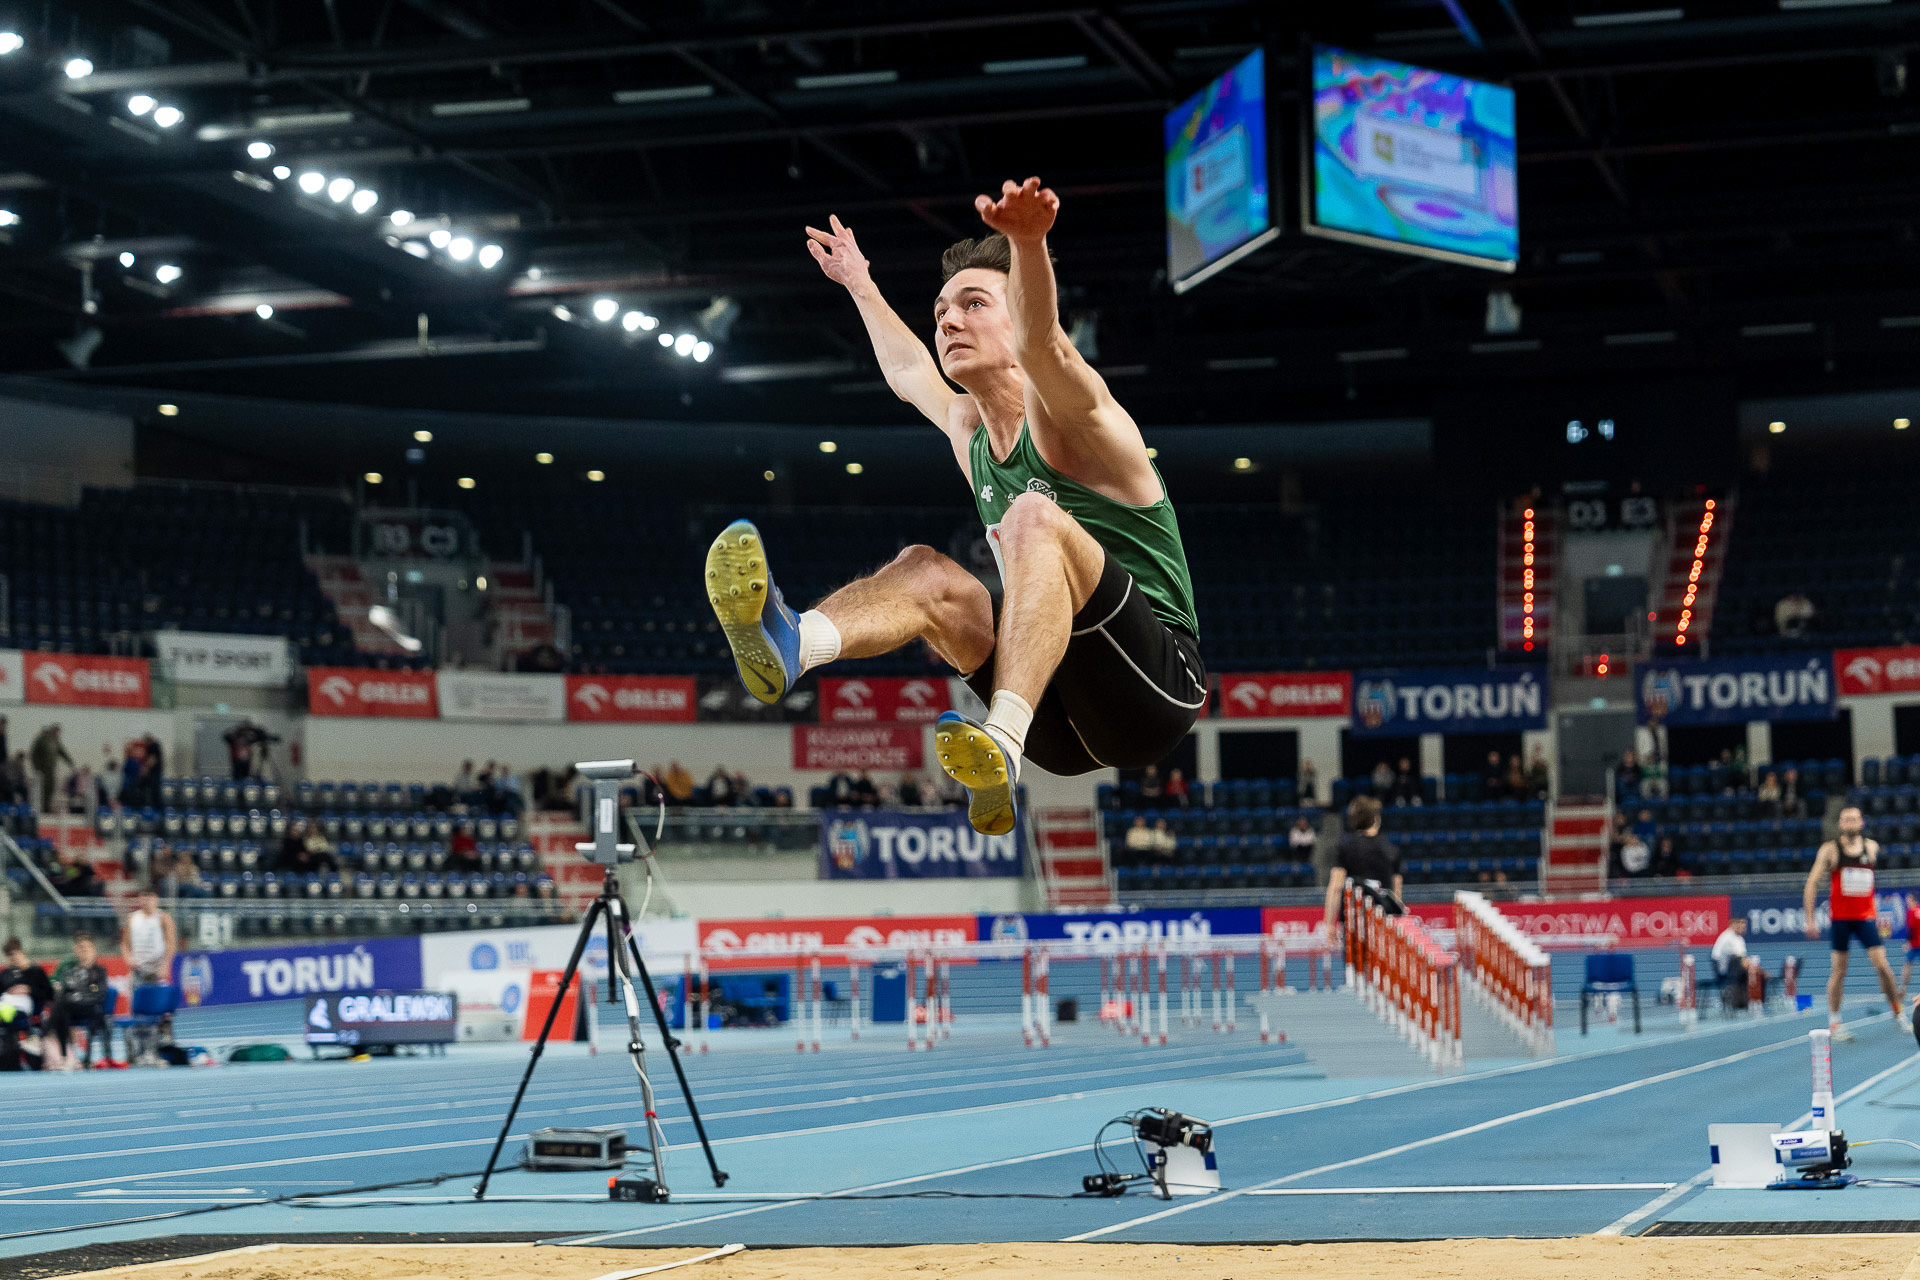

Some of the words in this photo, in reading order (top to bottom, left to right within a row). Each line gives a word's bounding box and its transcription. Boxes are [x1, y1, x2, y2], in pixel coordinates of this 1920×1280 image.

[213, 648, 271, 670] SPORT
[71, 667, 141, 693] ORLEN
[1683, 658, 1828, 710] TORUŃ
[358, 681, 429, 705] ORLEN
[613, 688, 687, 711] ORLEN
[1268, 683, 1344, 706] ORLEN
[1400, 672, 1541, 720] TORUŃ
[806, 728, 894, 747] KUJAWY
[806, 747, 909, 766] POMORZE
[200, 912, 232, 946] B1
[1631, 909, 1719, 937] POLSKI
[241, 944, 375, 997] TORUŃ
